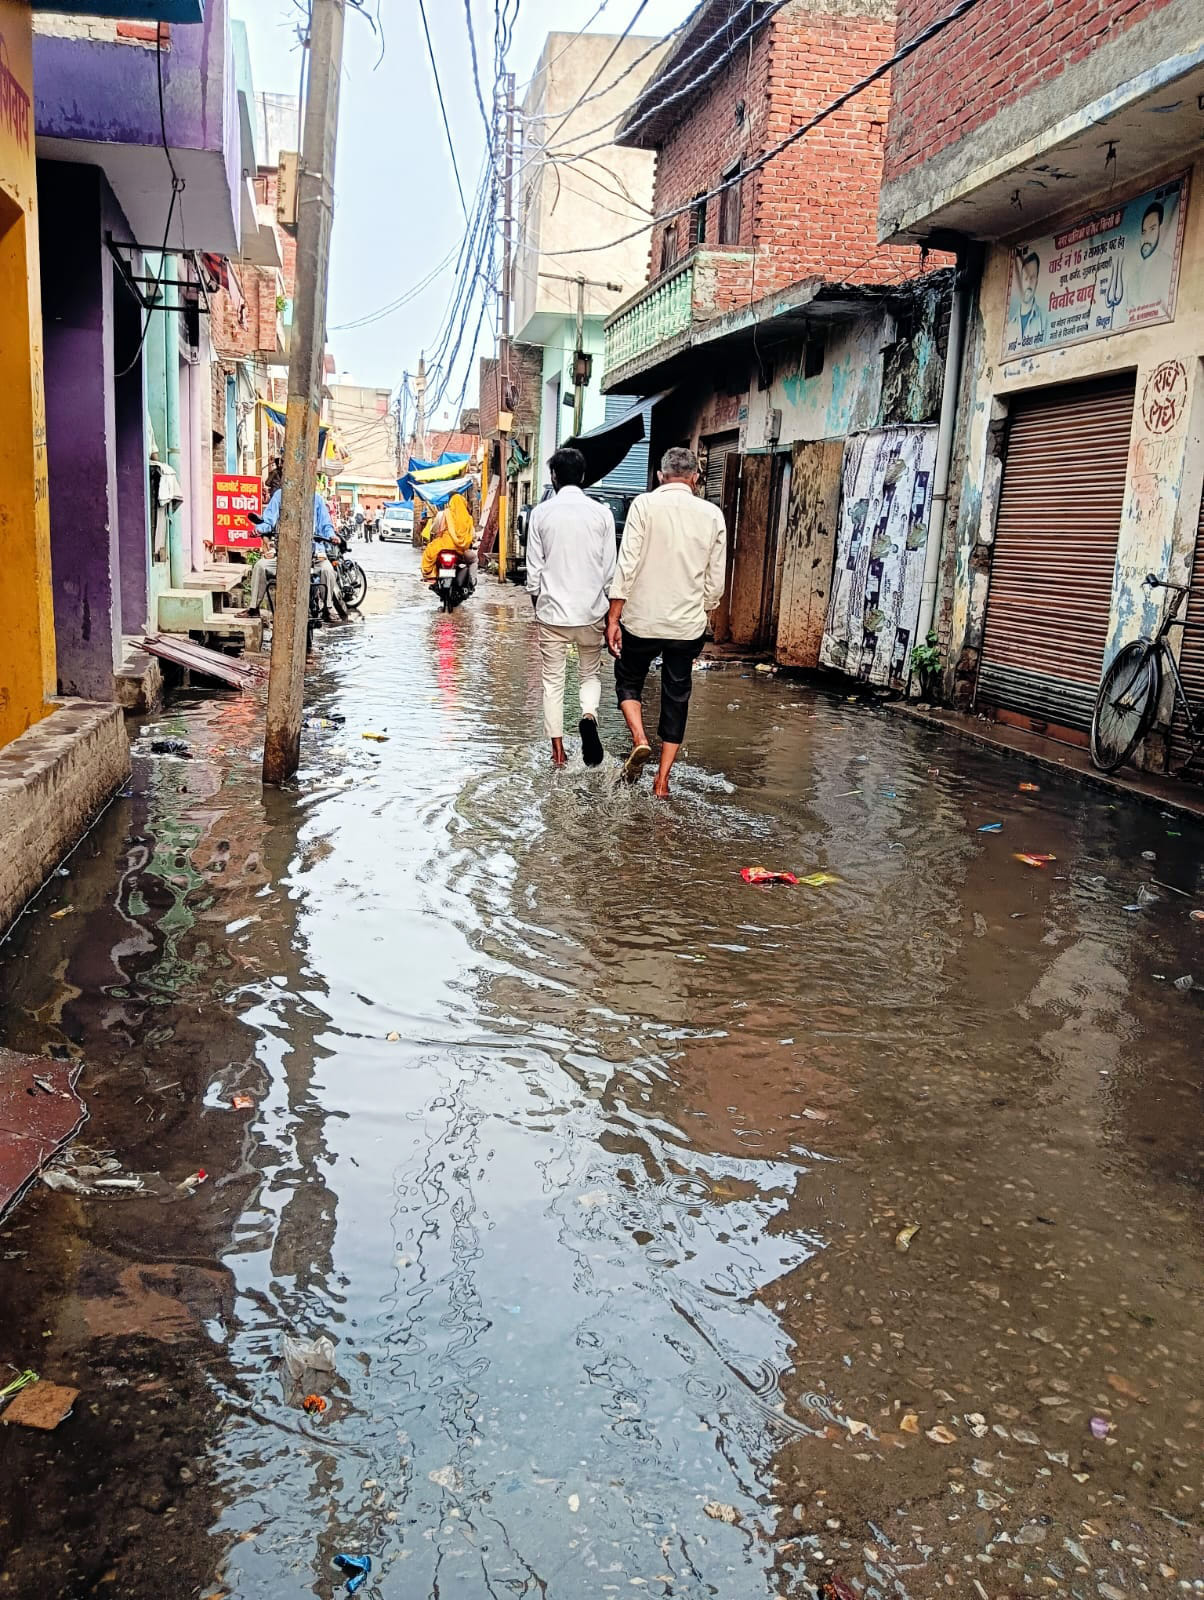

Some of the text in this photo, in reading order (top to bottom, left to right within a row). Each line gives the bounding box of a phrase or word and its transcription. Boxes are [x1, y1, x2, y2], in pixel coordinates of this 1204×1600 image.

[1073, 249, 1082, 265] 16
[1048, 286, 1075, 312] विनोद
[1076, 284, 1096, 305] बाबू
[231, 495, 259, 510] फोटो
[216, 514, 230, 526] 20
